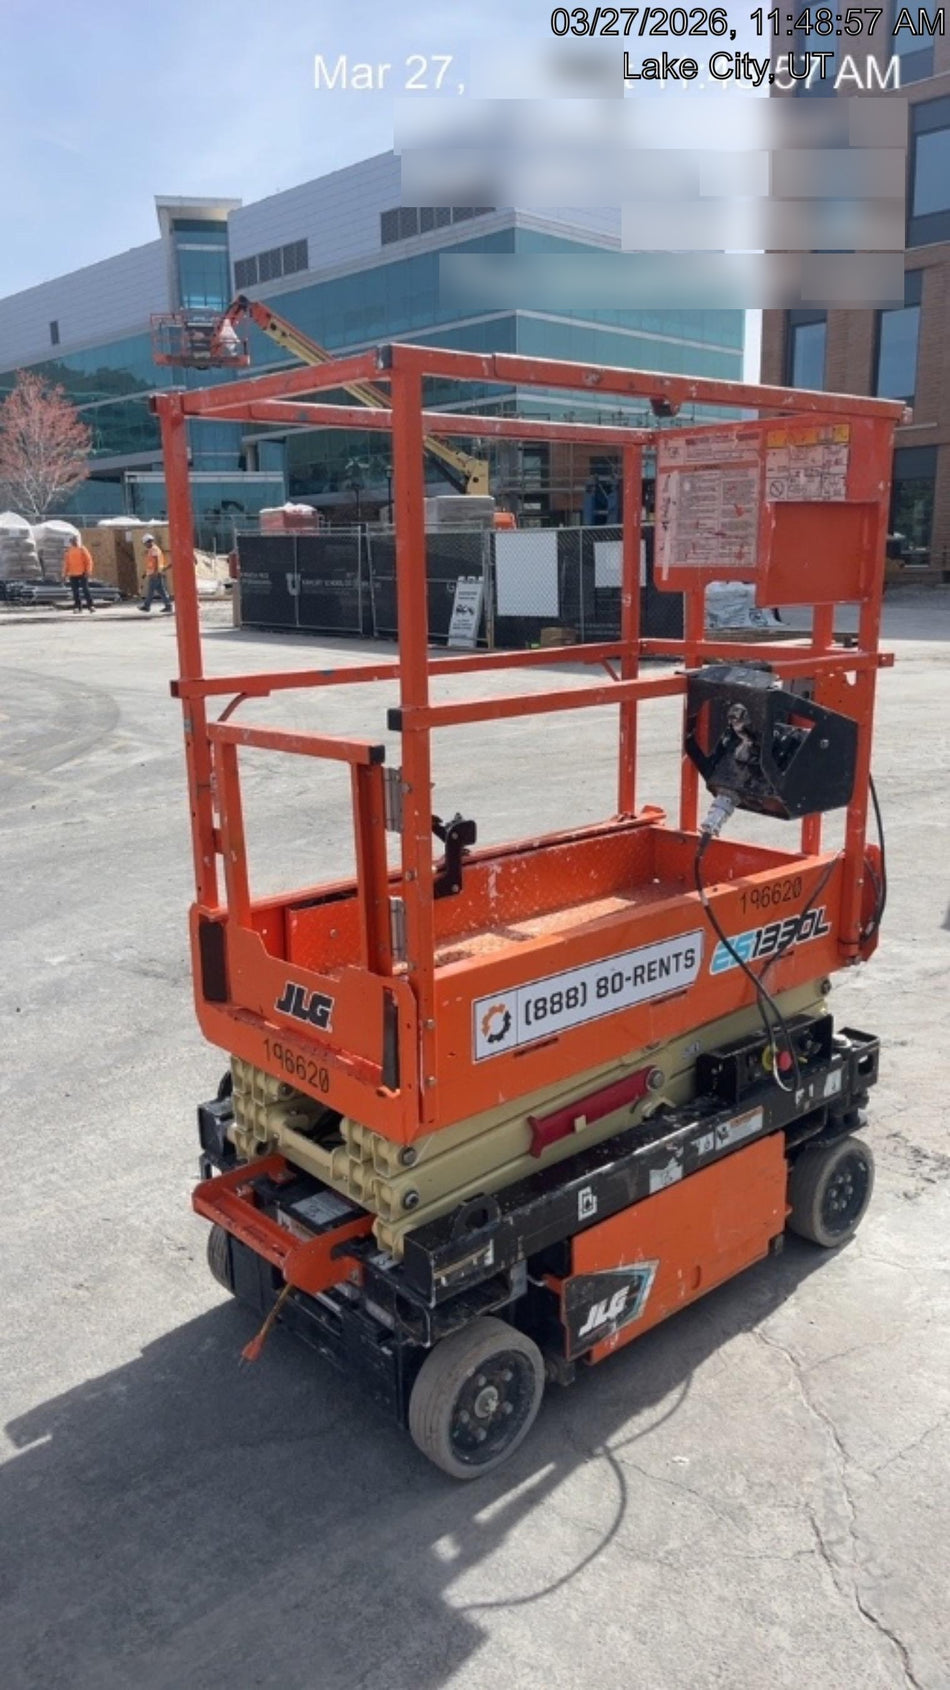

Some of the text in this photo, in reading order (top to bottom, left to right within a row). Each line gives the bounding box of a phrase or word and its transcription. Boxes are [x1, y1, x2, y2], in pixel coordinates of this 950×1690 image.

[740, 877, 803, 914] 196620
[710, 906, 831, 974] ES1330L
[275, 981, 334, 1031] JLG
[525, 948, 695, 1026] (888) 80-RENTS
[263, 1038, 330, 1094] 196620
[578, 1285, 630, 1337] JLG
